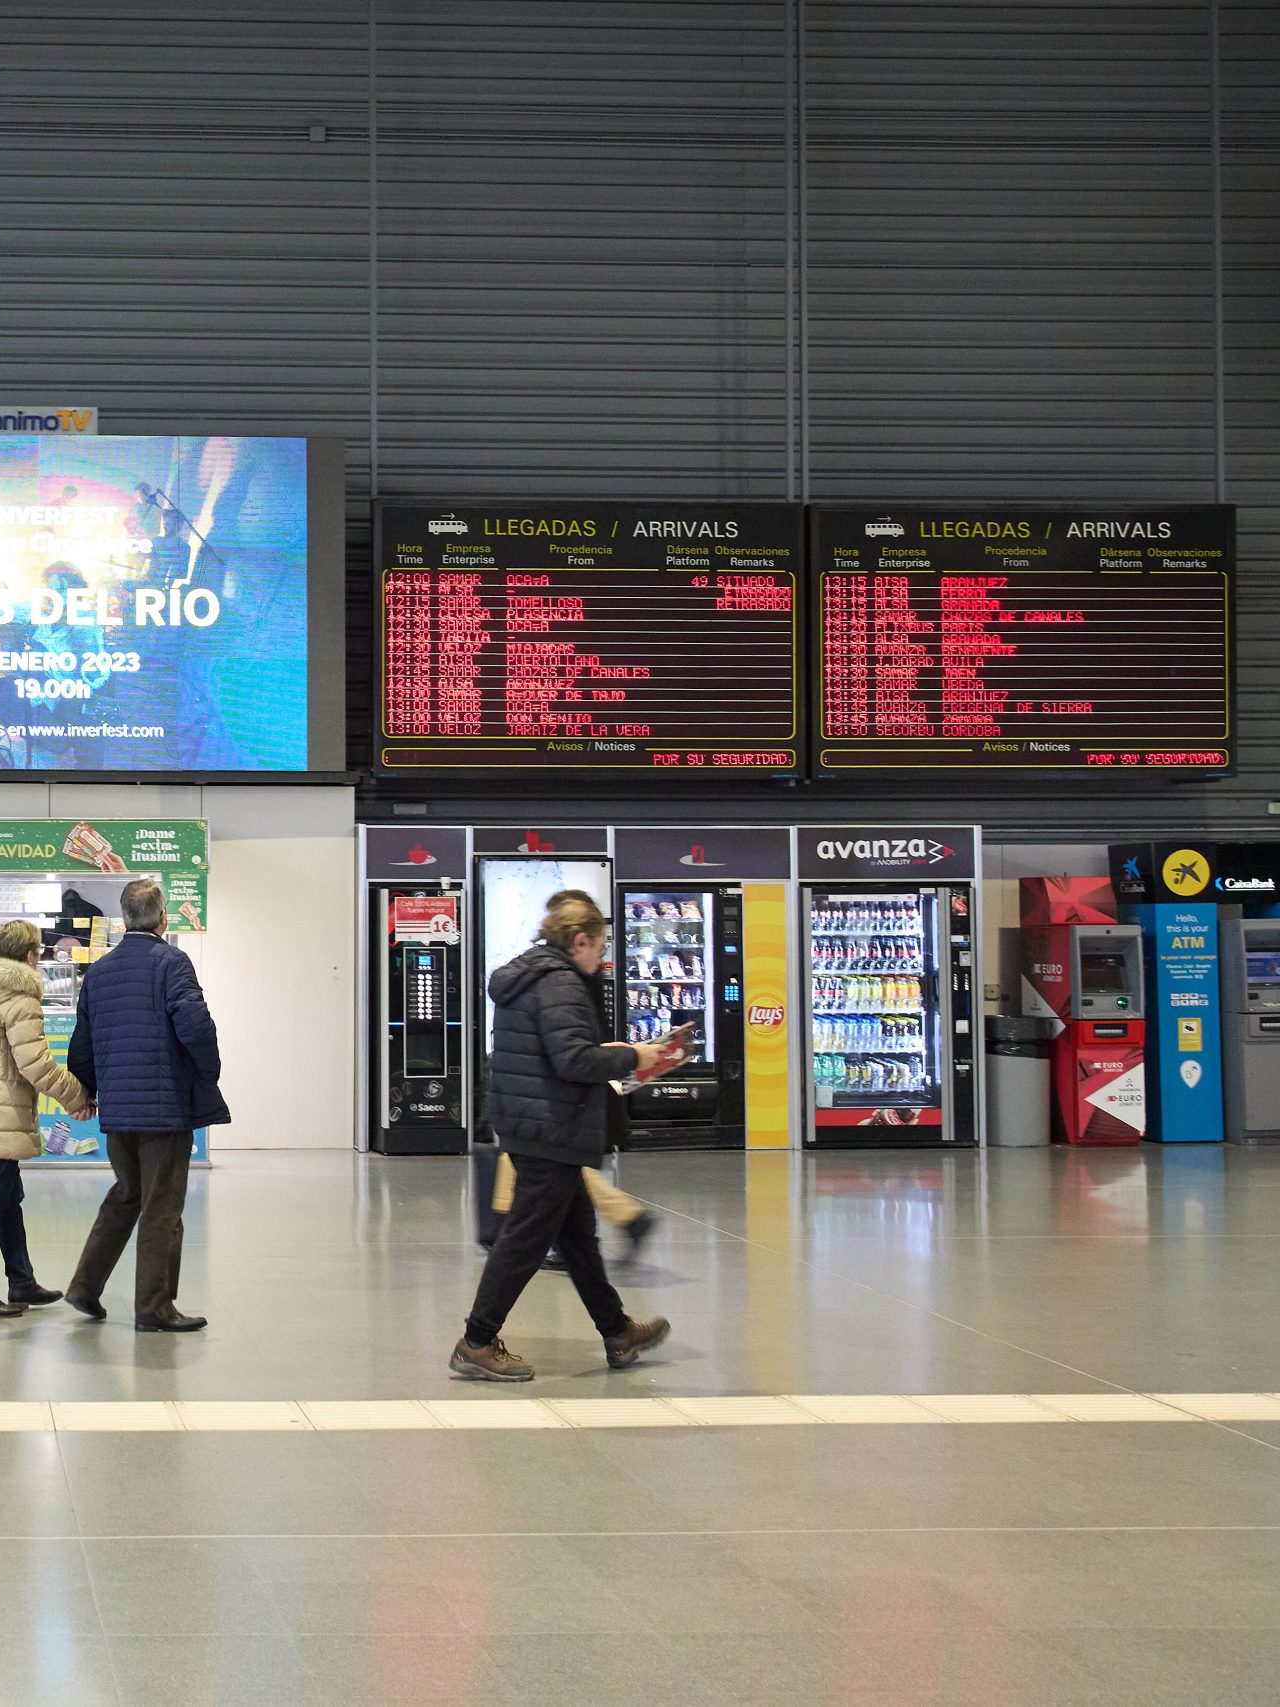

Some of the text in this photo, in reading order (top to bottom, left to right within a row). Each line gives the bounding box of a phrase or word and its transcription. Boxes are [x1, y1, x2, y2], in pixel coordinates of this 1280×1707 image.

[484, 520, 596, 537] LLEGADAS
[633, 521, 738, 538] ARRIVALS
[920, 522, 1030, 538] LLEGADAS
[1067, 522, 1170, 539] ARRIVALS
[397, 544, 422, 553] Hora
[446, 544, 490, 555] Empresa
[549, 544, 612, 555] Procedencia
[667, 545, 709, 555] Dársena
[715, 545, 789, 556] Observaciones
[834, 547, 859, 556] Hora
[882, 547, 926, 558] Empresa
[985, 546, 1047, 557] Procedencia
[1100, 548, 1141, 558] Dársena
[1147, 548, 1221, 558] Observaciones
[397, 555, 423, 565] Time
[442, 555, 494, 566] Enterprise
[568, 556, 594, 565] From
[666, 556, 709, 567] Platform
[730, 557, 774, 567] Remarks
[833, 558, 859, 568] Time
[878, 558, 930, 569] Enterprise
[1003, 558, 1029, 567] From
[1099, 559, 1142, 569] Platform
[1163, 559, 1207, 569] Remarks
[30, 588, 123, 626] DEL
[717, 599, 791, 610] RETRASADO
[81, 652, 140, 672] 2023
[507, 656, 599, 666] PUERTOLLANO
[14, 679, 90, 699] 19.00h
[10, 727, 25, 736] en
[28, 722, 164, 738] www.inverfest.com
[388, 724, 650, 735] 13:00 VELOZ JARAIZ DE LA VERA
[826, 726, 1000, 736] 13:50 SECORBU CORDOBA
[547, 741, 583, 752] Avisos
[595, 741, 635, 752] Notices
[983, 742, 1018, 753] Avisos
[1029, 742, 1070, 752] Notices
[654, 754, 679, 765] POR
[136, 830, 175, 839] ¡Dame
[817, 839, 926, 859] avanza
[132, 850, 180, 862] ilusión!
[1225, 878, 1275, 888] CaixaBank
[1176, 914, 1198, 922] Hello,
[434, 921, 450, 932] 1€
[1171, 937, 1204, 948] ATM
[1042, 964, 1062, 974] EURO
[750, 1006, 783, 1025] Lay's
